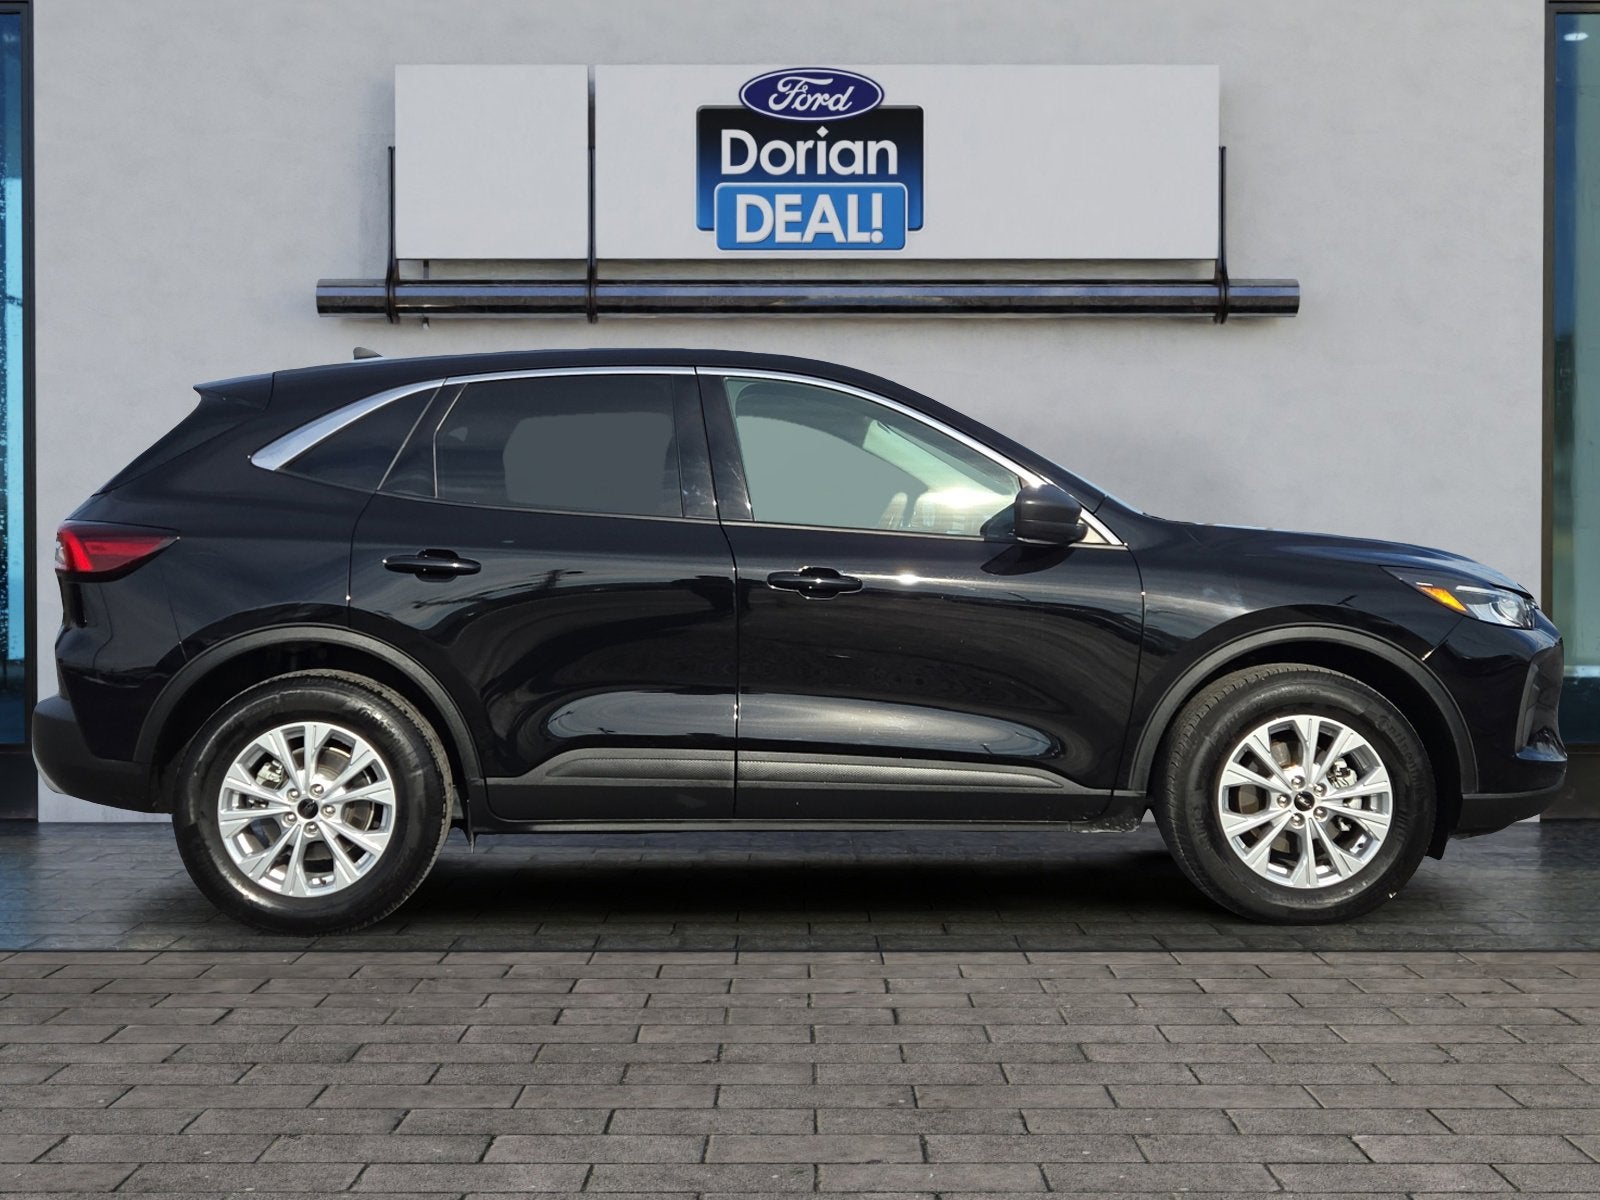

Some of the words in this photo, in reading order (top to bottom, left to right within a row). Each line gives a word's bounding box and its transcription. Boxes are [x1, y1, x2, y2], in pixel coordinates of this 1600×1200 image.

[768, 76, 855, 112] Ford
[721, 125, 898, 176] Dorian
[736, 193, 884, 244] DEAL!
